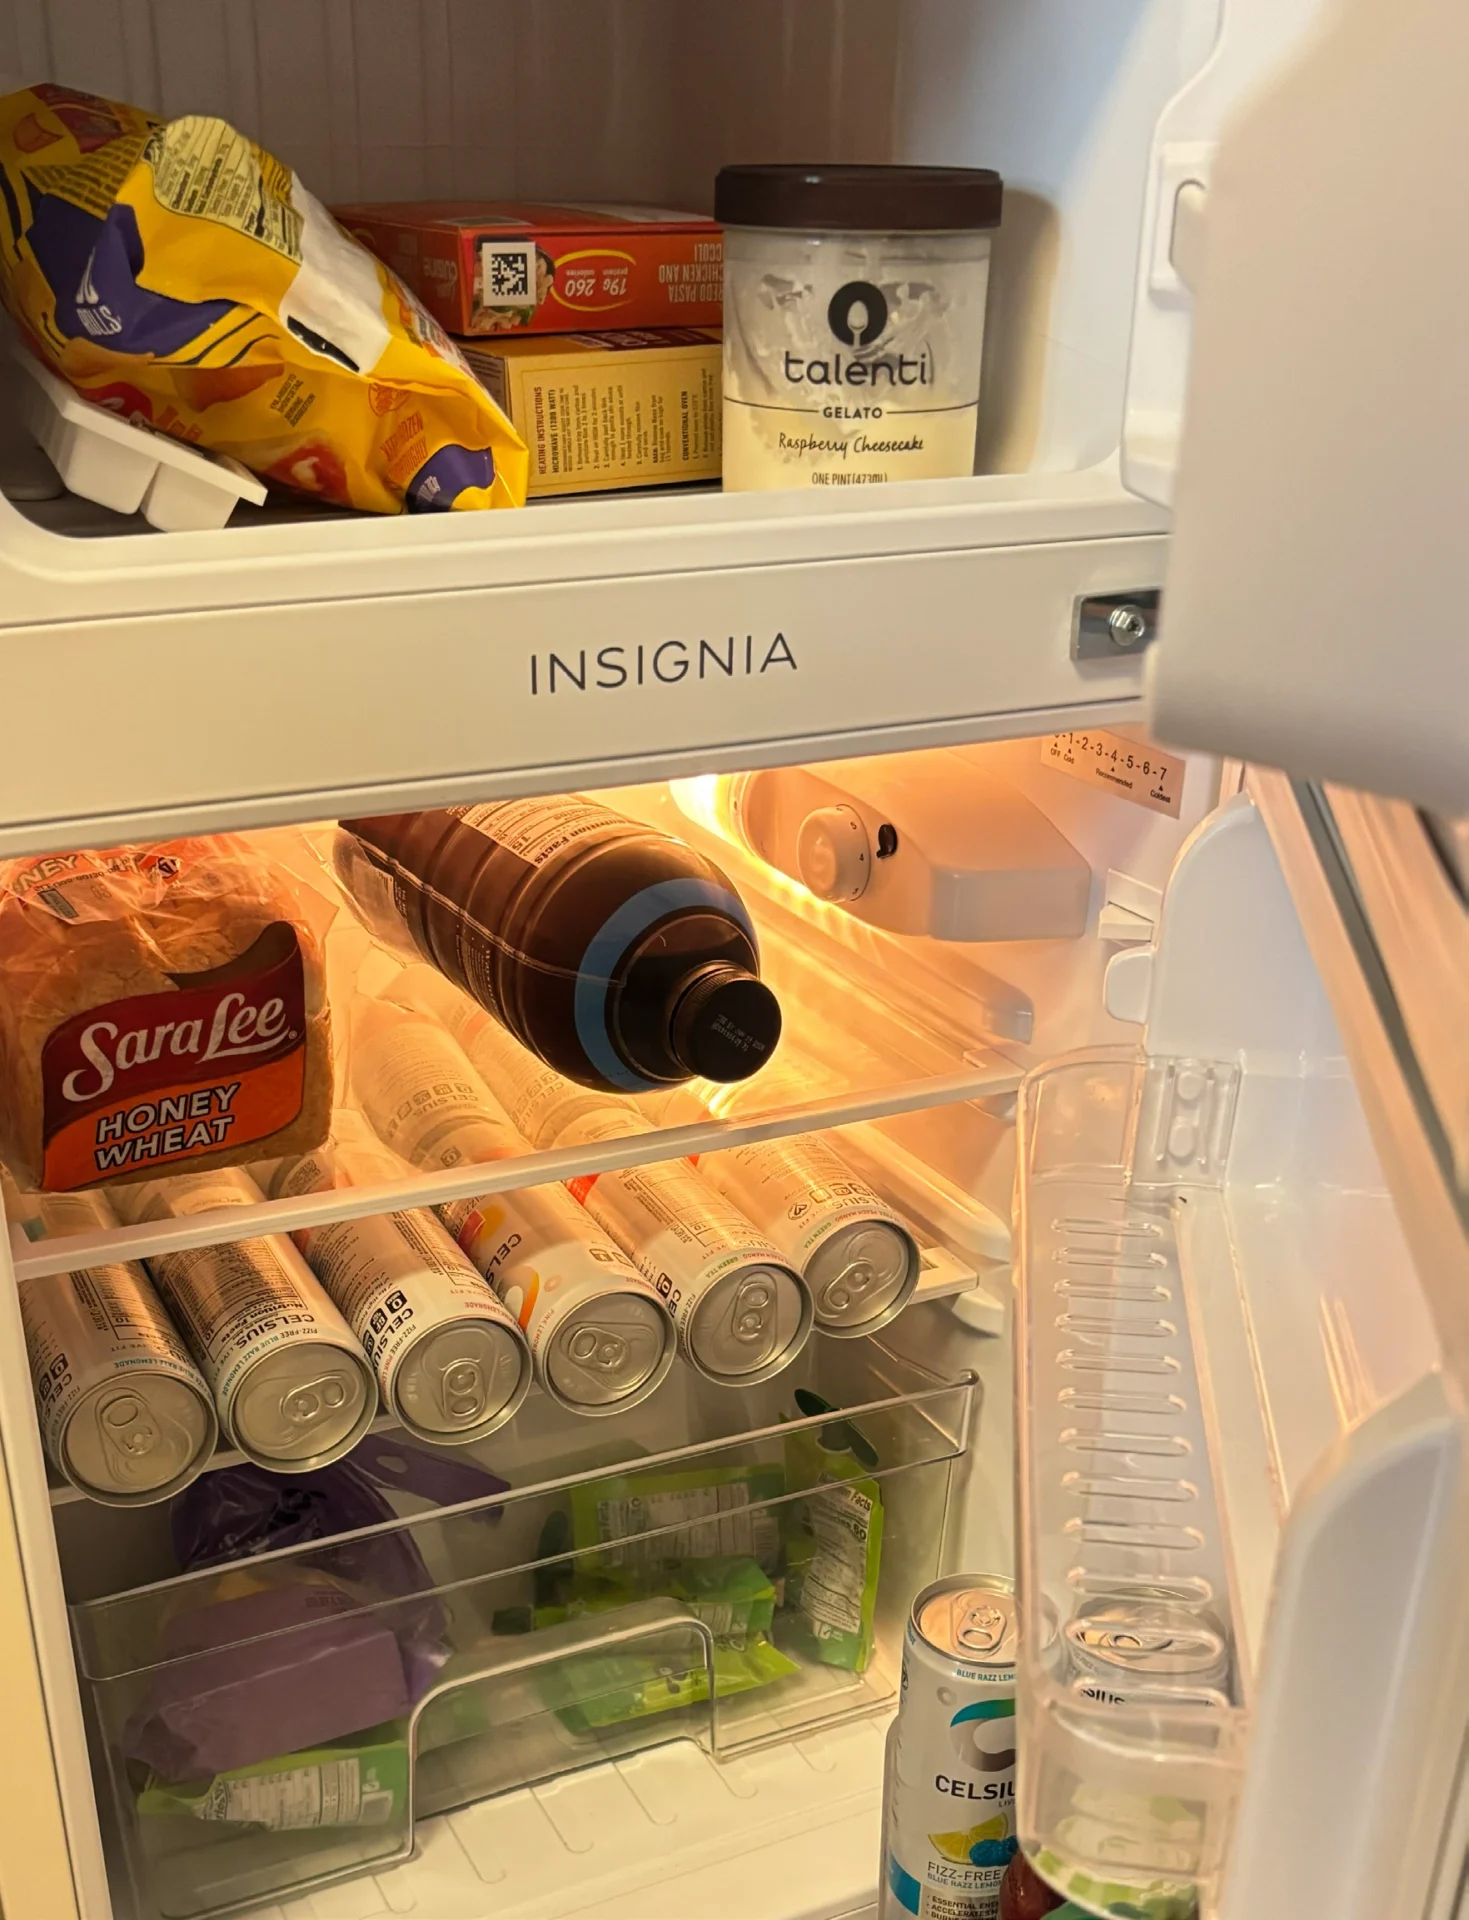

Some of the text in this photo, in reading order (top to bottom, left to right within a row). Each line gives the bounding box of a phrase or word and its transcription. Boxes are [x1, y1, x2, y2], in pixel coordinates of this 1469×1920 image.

[659, 265, 679, 283] AND
[565, 279, 596, 297] 260
[668, 284, 724, 302] REDO PASTA
[784, 351, 927, 385] talenti
[548, 390, 557, 410] WATT)
[823, 406, 883, 419] GELATO
[534, 387, 547, 474] HEATING INSTRUCTIONS
[550, 433, 559, 473] MICROWAVE
[778, 432, 923, 460] Raspberry Cheesecake
[812, 472, 829, 485] ONE
[832, 473, 851, 485] PINT
[531, 632, 798, 695] INSIGNIA
[1096, 768, 1132, 789] Recommended
[1150, 789, 1171, 803] Coldest
[534, 837, 570, 864] Facts
[860, 853, 864, 861] 4
[12, 854, 78, 894] NEY
[62, 992, 289, 1102] Sara Lee
[96, 1082, 241, 1144] HONEY
[95, 1115, 234, 1171] WHEAT
[485, 1234, 521, 1285] CELS
[718, 1256, 738, 1270] GREEN
[239, 1314, 315, 1349] CELSIUS
[372, 1308, 413, 1373] CELSIU
[390, 1324, 416, 1354] FIZZ-FREE
[114, 1358, 158, 1369] LEMONADE
[222, 1328, 318, 1397] FIZZ-FREE BLUE RAZZ LEMONADE
[957, 1669, 976, 1680] BLUE
[977, 1673, 997, 1682] RAZZ
[928, 1861, 1001, 1881] FIZZ-FREE
[928, 1872, 1001, 1889] BLUE RAZZ LEMO
[932, 1896, 978, 1909] ESSENTIAL
[932, 1904, 991, 1917] ACCELERATES
